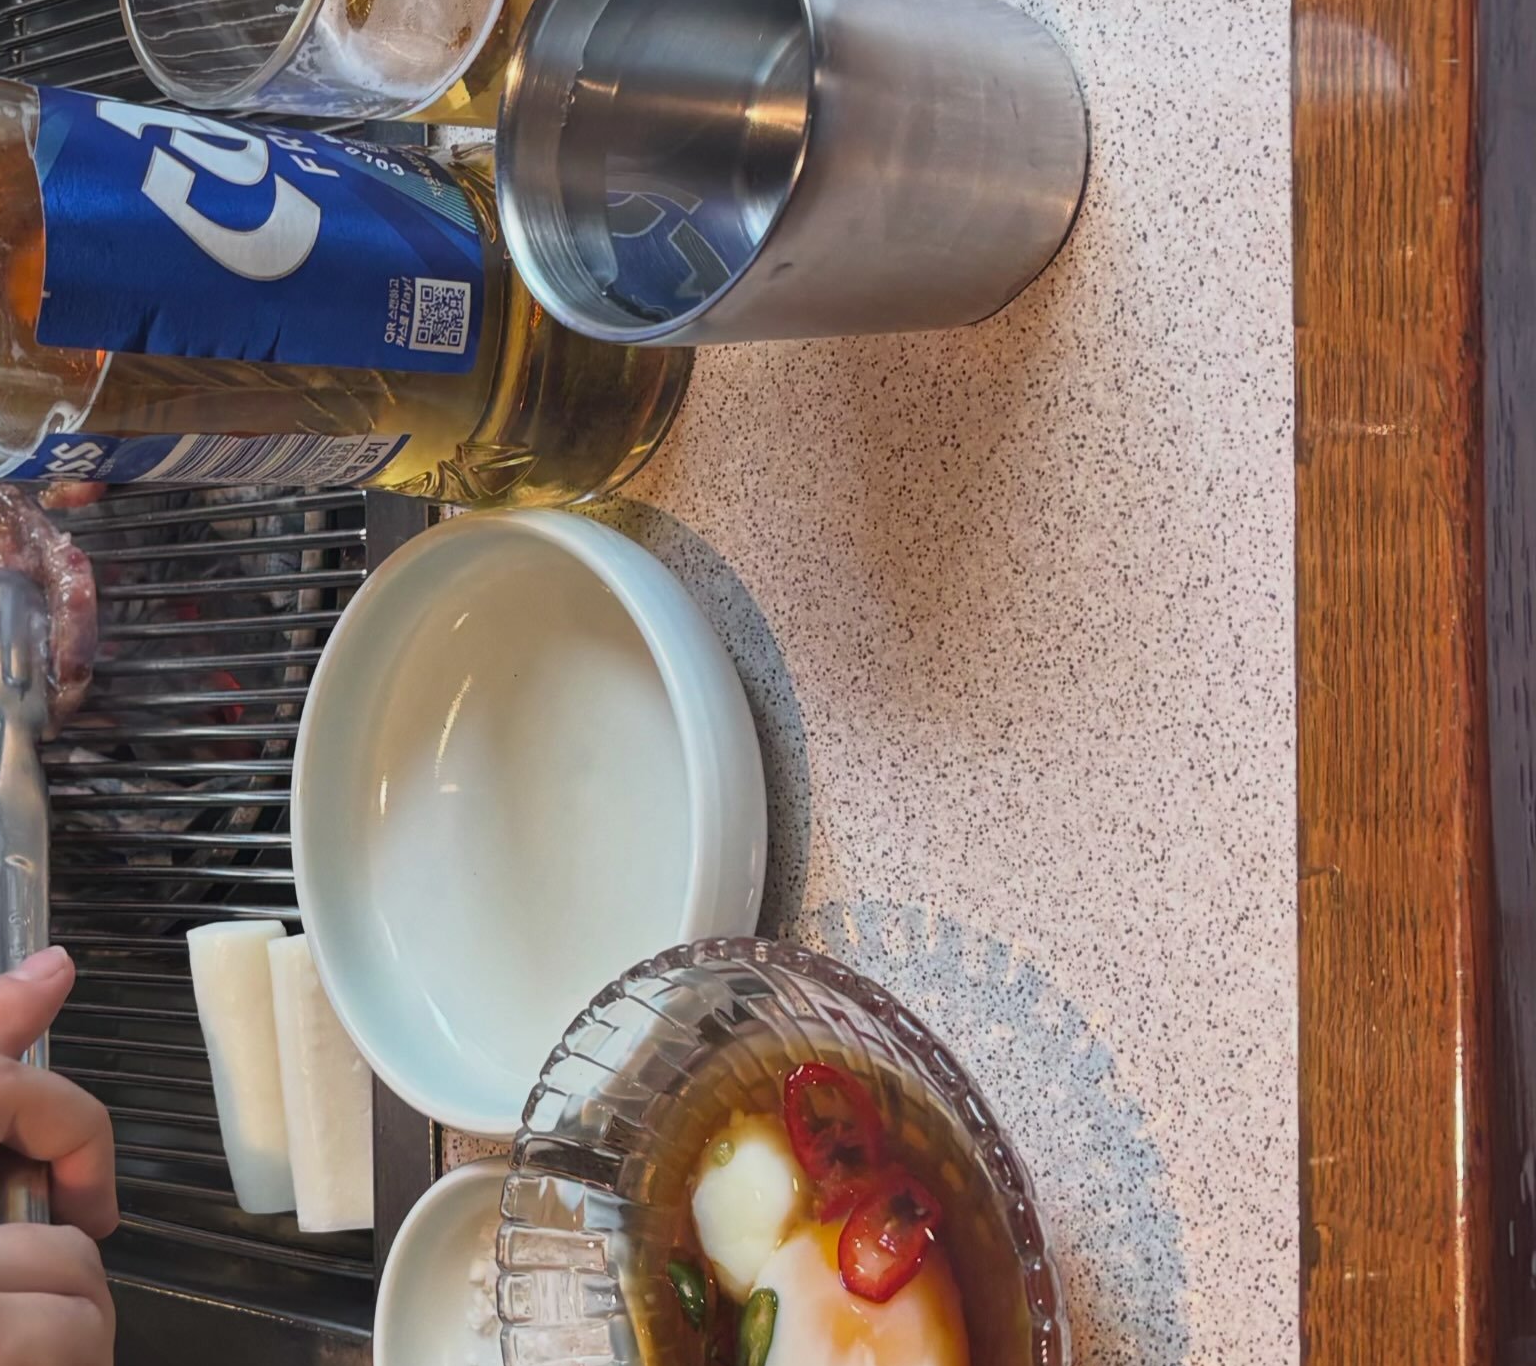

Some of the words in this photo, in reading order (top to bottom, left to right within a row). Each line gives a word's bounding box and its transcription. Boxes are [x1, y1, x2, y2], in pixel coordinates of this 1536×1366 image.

[388, 278, 400, 320] 스캔하고
[400, 276, 413, 313] Play!
[384, 322, 397, 343] QR
[353, 442, 389, 464] 금지
